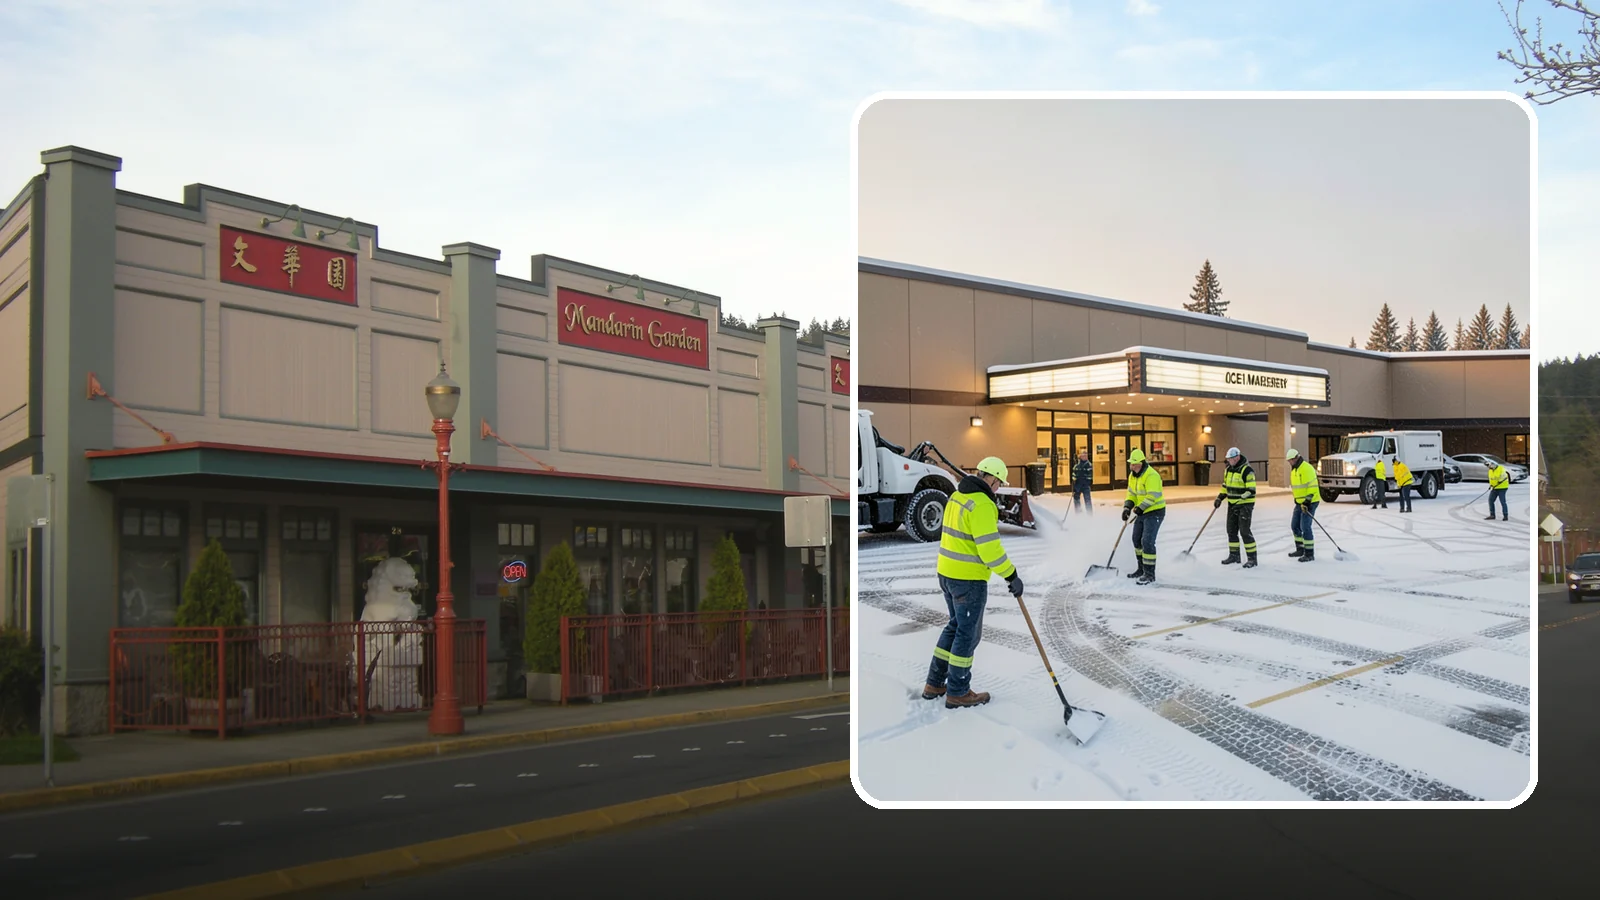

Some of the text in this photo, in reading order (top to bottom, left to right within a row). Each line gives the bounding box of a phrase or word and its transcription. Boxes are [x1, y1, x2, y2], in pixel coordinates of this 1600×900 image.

[564, 302, 702, 352] Mandarin Garden
[503, 565, 527, 578] OPEN
